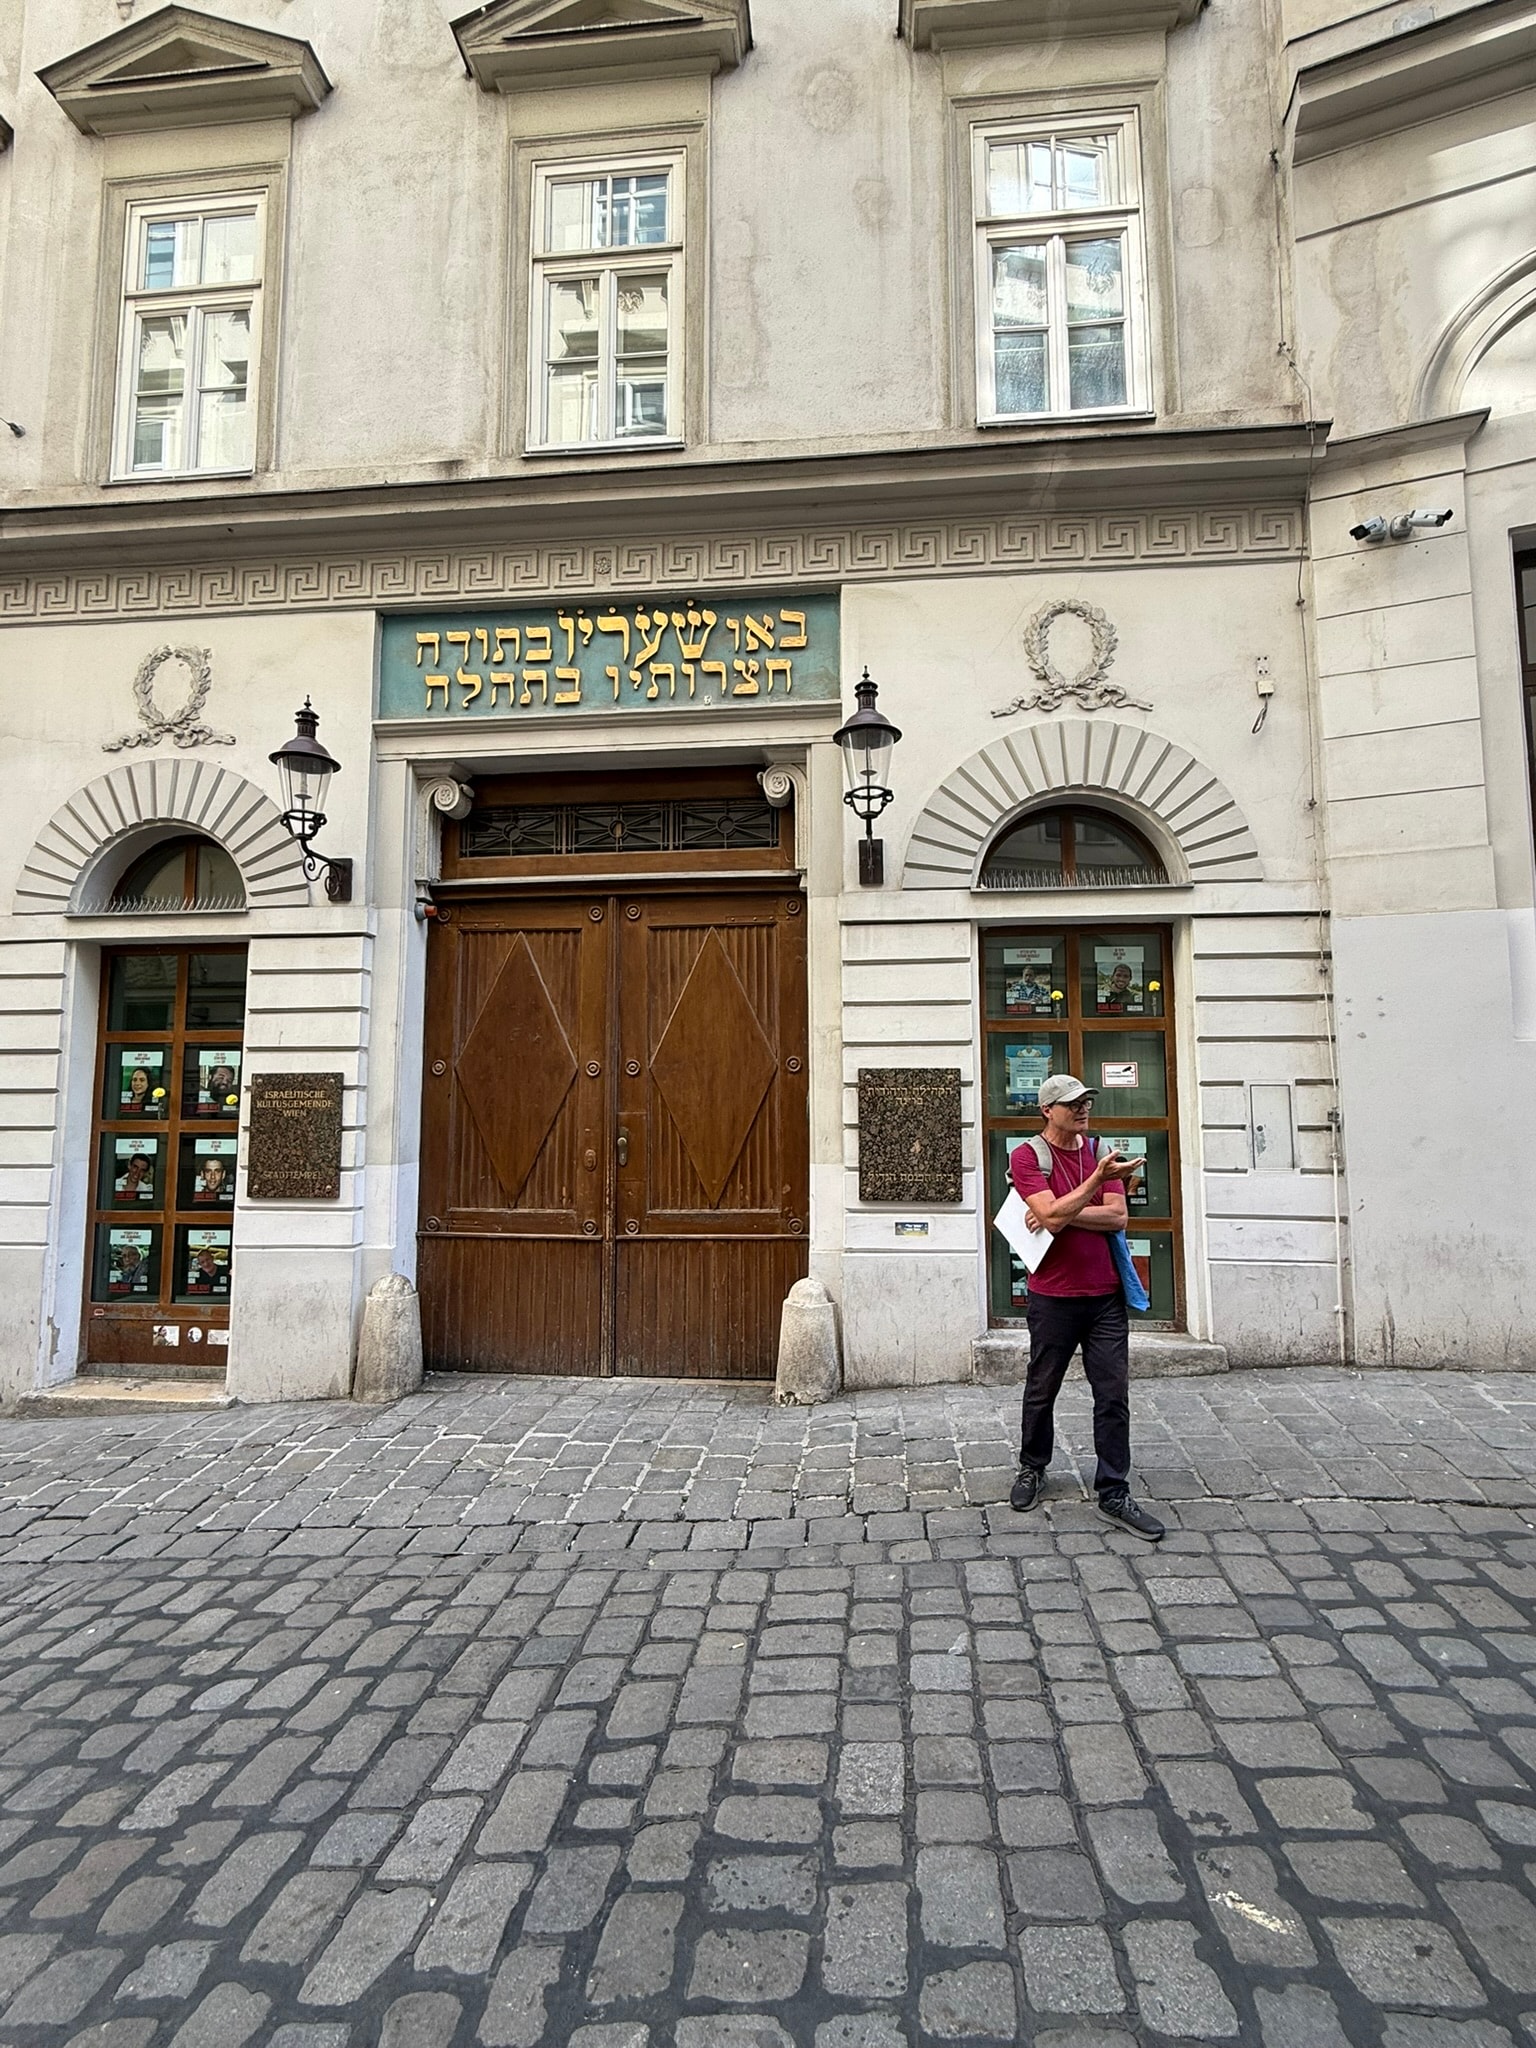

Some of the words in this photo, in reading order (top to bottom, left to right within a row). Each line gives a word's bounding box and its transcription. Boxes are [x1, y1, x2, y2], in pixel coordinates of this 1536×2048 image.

[726, 608, 808, 653] באו
[415, 624, 554, 668] בתודה
[424, 665, 582, 710] בתהלה
[605, 658, 793, 702] חצרותיו
[256, 1099, 334, 1108] KULTUSGEMEINDE
[264, 1090, 326, 1099] ISRAELITISCHE
[283, 1109, 307, 1117] WIEN
[263, 1170, 323, 1180] STADTTEMPEL
